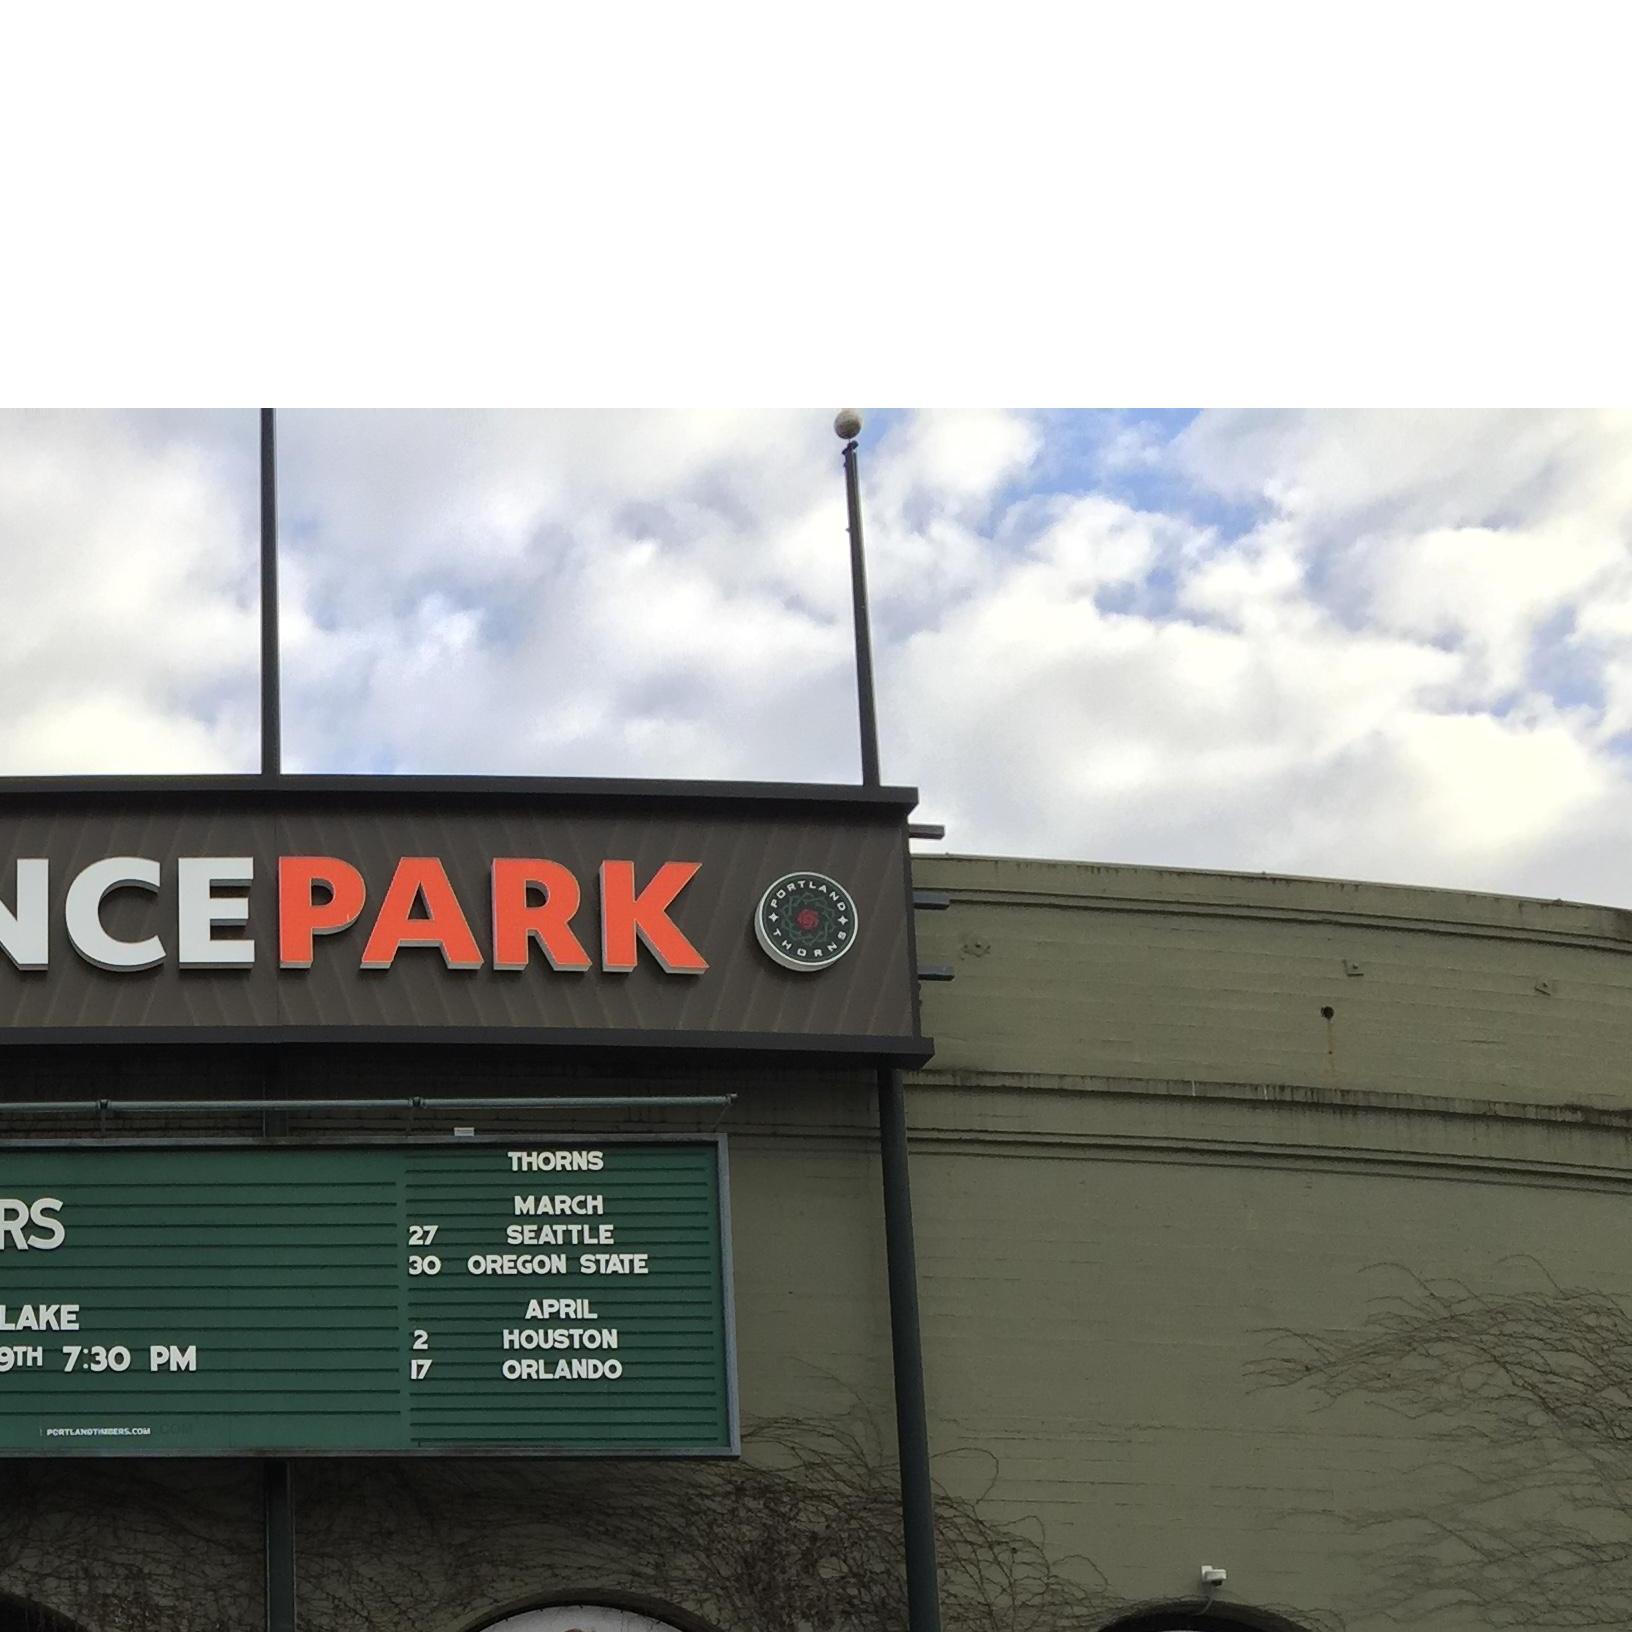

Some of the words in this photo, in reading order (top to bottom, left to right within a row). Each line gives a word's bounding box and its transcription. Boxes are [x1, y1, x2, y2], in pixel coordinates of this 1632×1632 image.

[770, 880, 846, 911] PORTLAND
[279, 855, 709, 974] PARK
[773, 929, 847, 957] THORNS
[508, 1150, 604, 1172] THORNS
[514, 1194, 604, 1216] MARCH
[408, 1224, 439, 1246] 27
[506, 1224, 614, 1245] SEATTLE
[408, 1255, 441, 1276] 30
[467, 1253, 567, 1275] OREGON
[579, 1253, 649, 1275] STATE
[524, 1298, 598, 1320] APRIL
[412, 1329, 429, 1350] 2
[502, 1328, 619, 1350] HOUSTON
[62, 1345, 132, 1372] 7:30
[149, 1345, 198, 1372] PM
[410, 1358, 433, 1380] 17
[502, 1358, 623, 1380] ORLANDO
[46, 1427, 151, 1437] PORTLANDTIMBERS.COM
